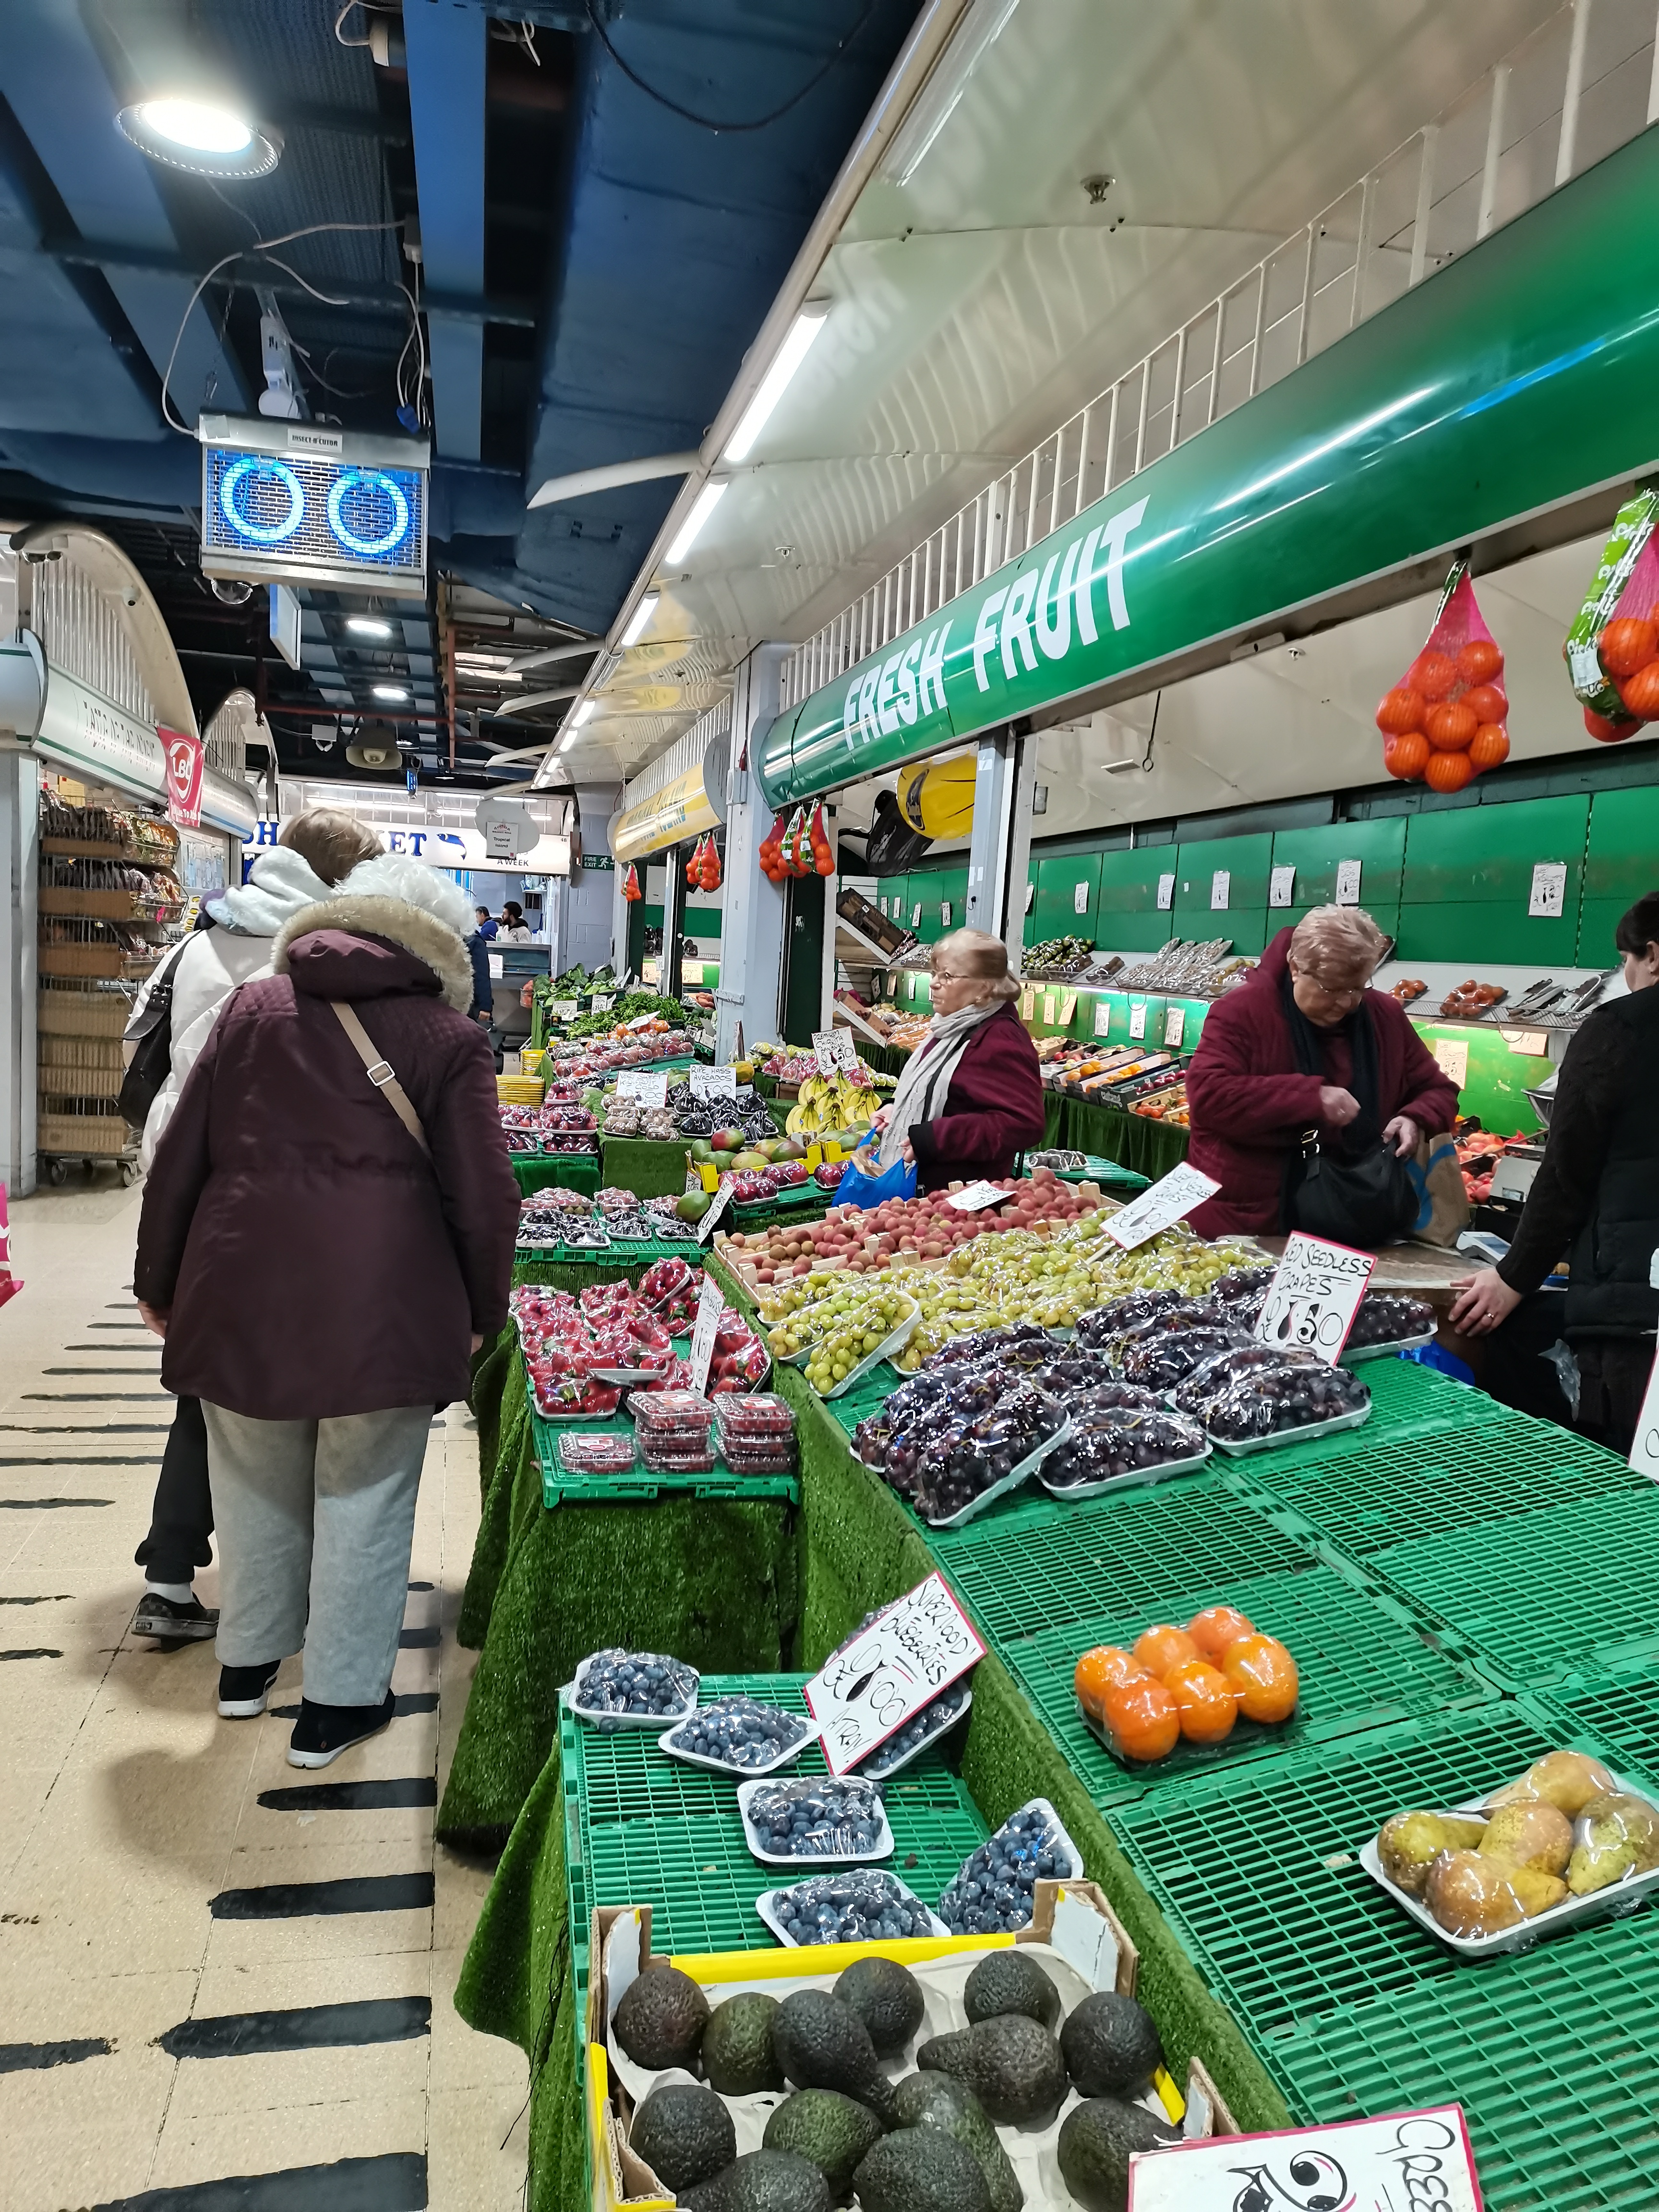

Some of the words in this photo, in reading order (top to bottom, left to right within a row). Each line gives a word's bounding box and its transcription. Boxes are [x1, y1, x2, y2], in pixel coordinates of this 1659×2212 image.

[843, 618, 954, 750] FRESH
[973, 494, 1151, 693] FRUIT
[505, 858, 529, 866] WEEK
[813, 1030, 840, 1042] PREMIUM
[816, 1035, 844, 1048] CHIQUITA
[619, 1072, 636, 1080] VERY
[691, 1066, 707, 1074] RIPE
[1284, 1237, 1303, 1263] RED
[1301, 1243, 1371, 1277] SEEDLESS
[1278, 1271, 1332, 1296] GRAPES
[880, 1606, 947, 1685] BLUEBERRIES
